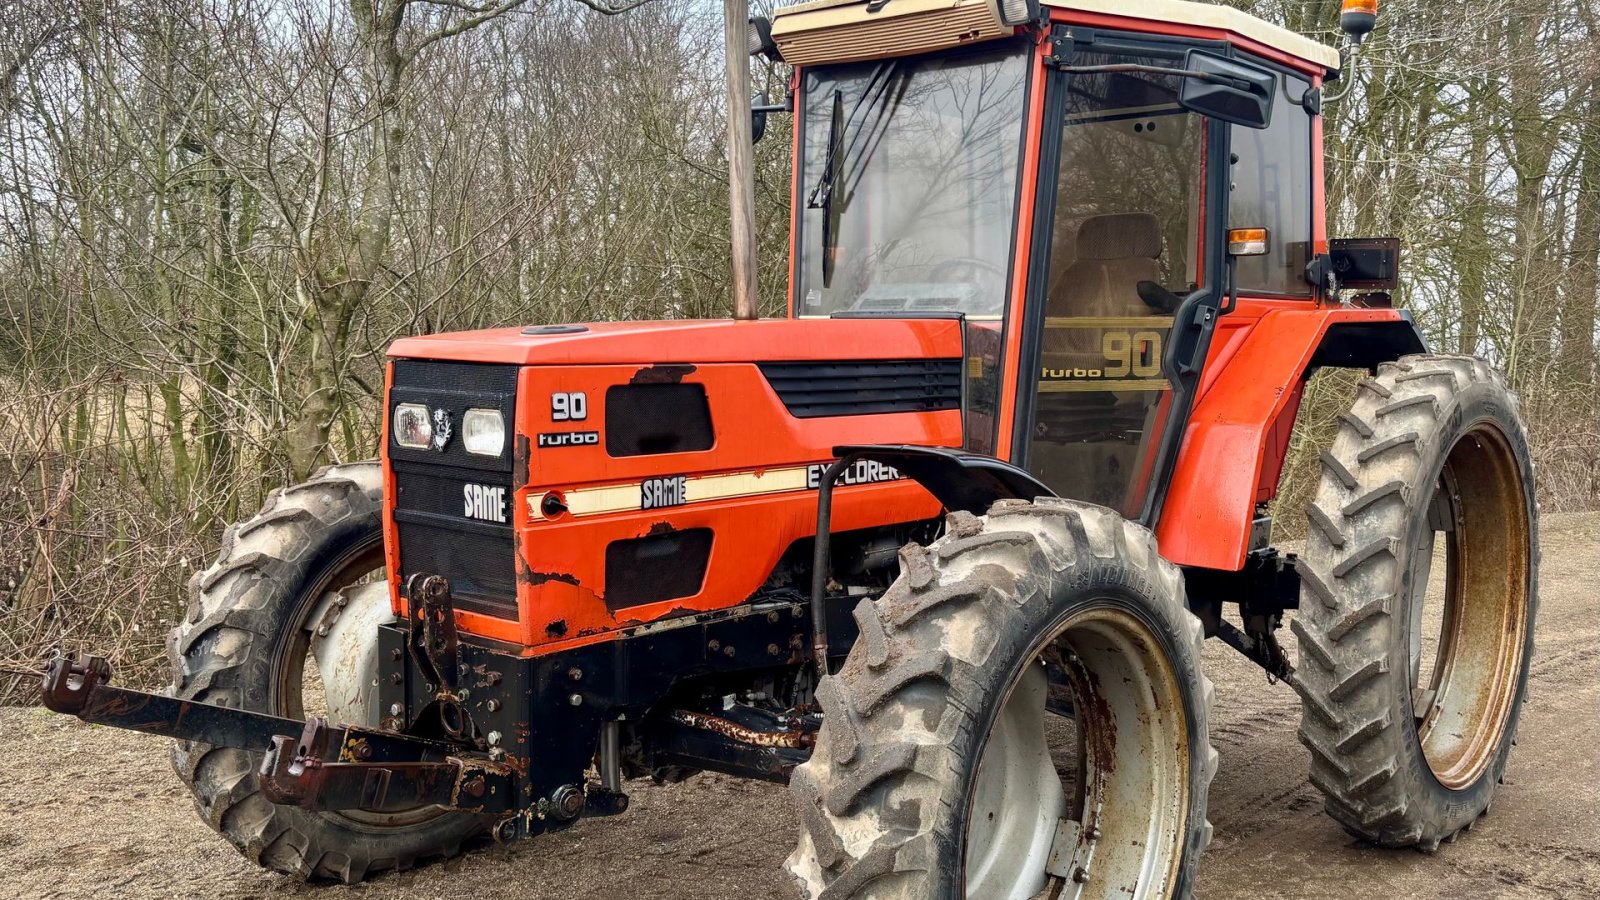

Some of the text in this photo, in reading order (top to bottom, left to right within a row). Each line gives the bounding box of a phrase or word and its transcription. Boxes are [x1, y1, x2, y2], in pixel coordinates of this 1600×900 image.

[1042, 331, 1161, 378] turbo 90
[552, 392, 586, 420] 90
[539, 432, 598, 446] turbo
[807, 459, 900, 488] EXLORER
[463, 483, 506, 523] SAME
[643, 476, 687, 510] SAME
